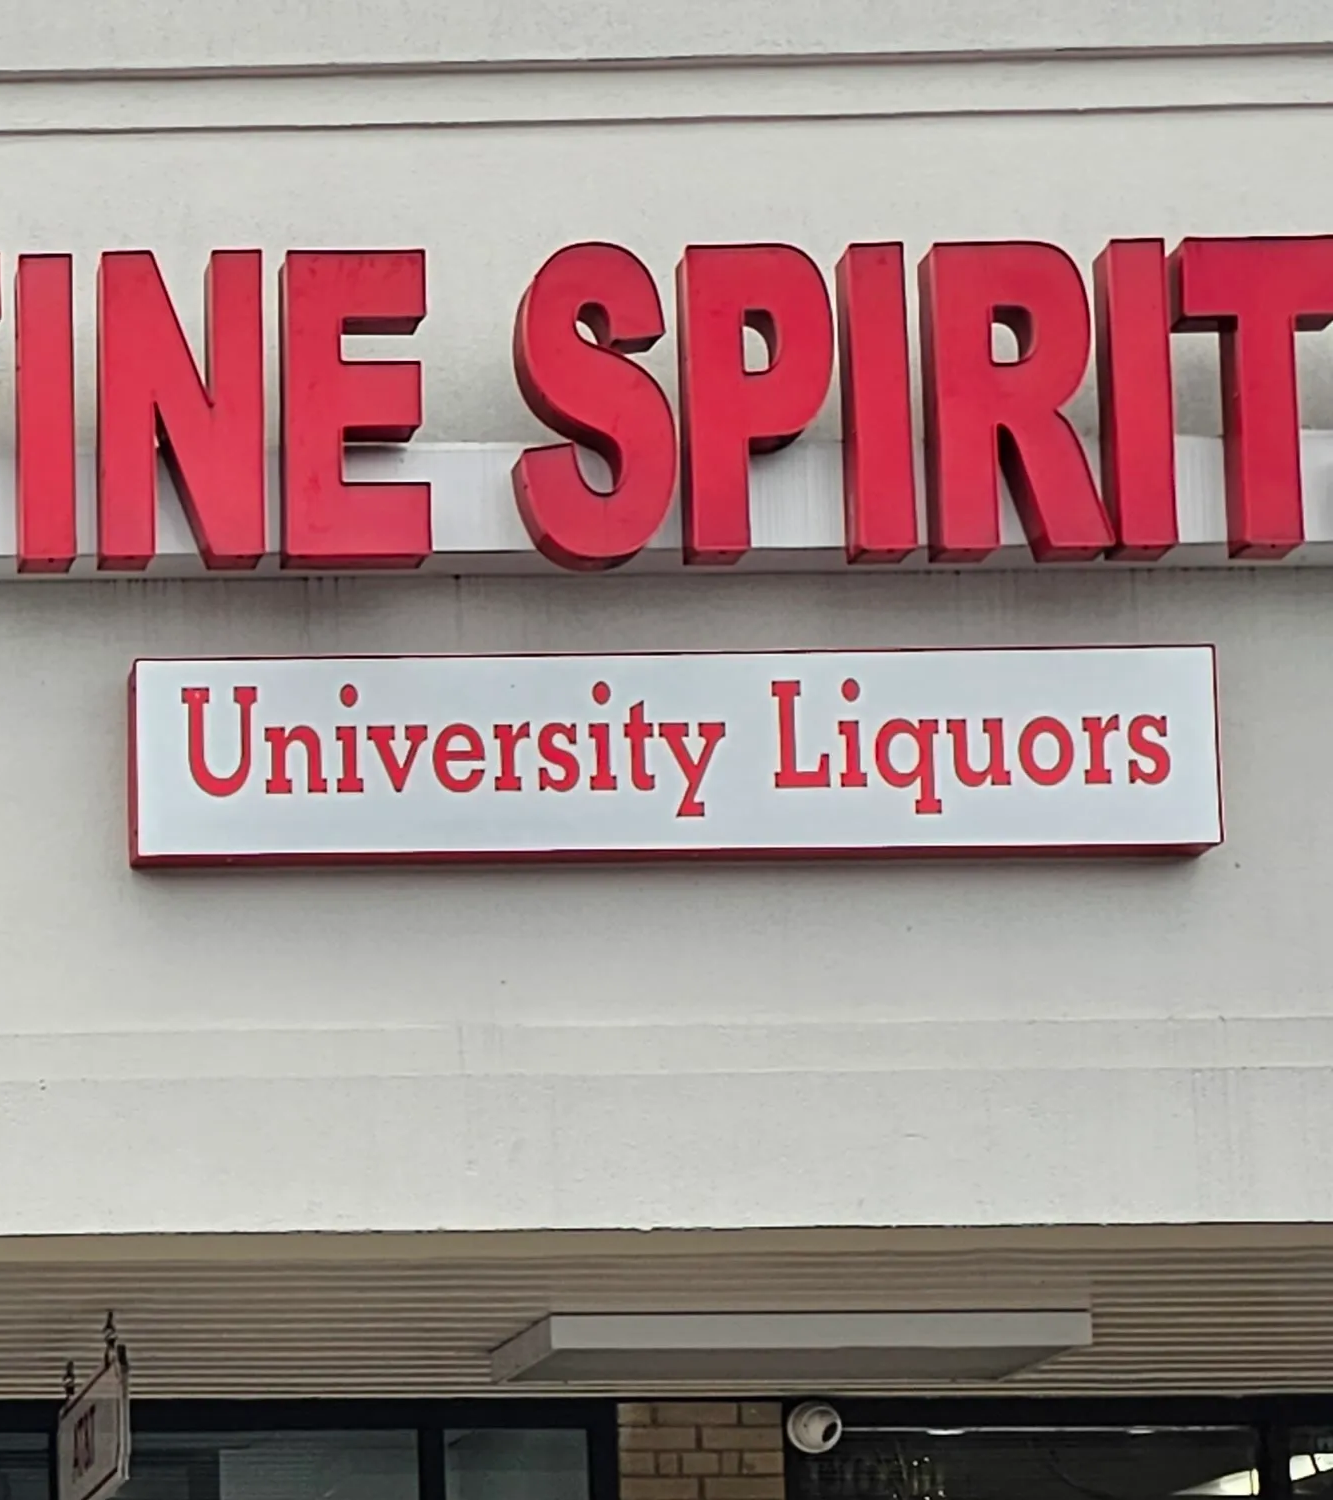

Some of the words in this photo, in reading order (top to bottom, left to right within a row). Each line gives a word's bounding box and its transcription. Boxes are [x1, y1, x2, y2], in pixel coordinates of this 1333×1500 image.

[511, 234, 1333, 571] SPIRIT
[180, 681, 727, 816] University
[770, 677, 1171, 815] Liquors
